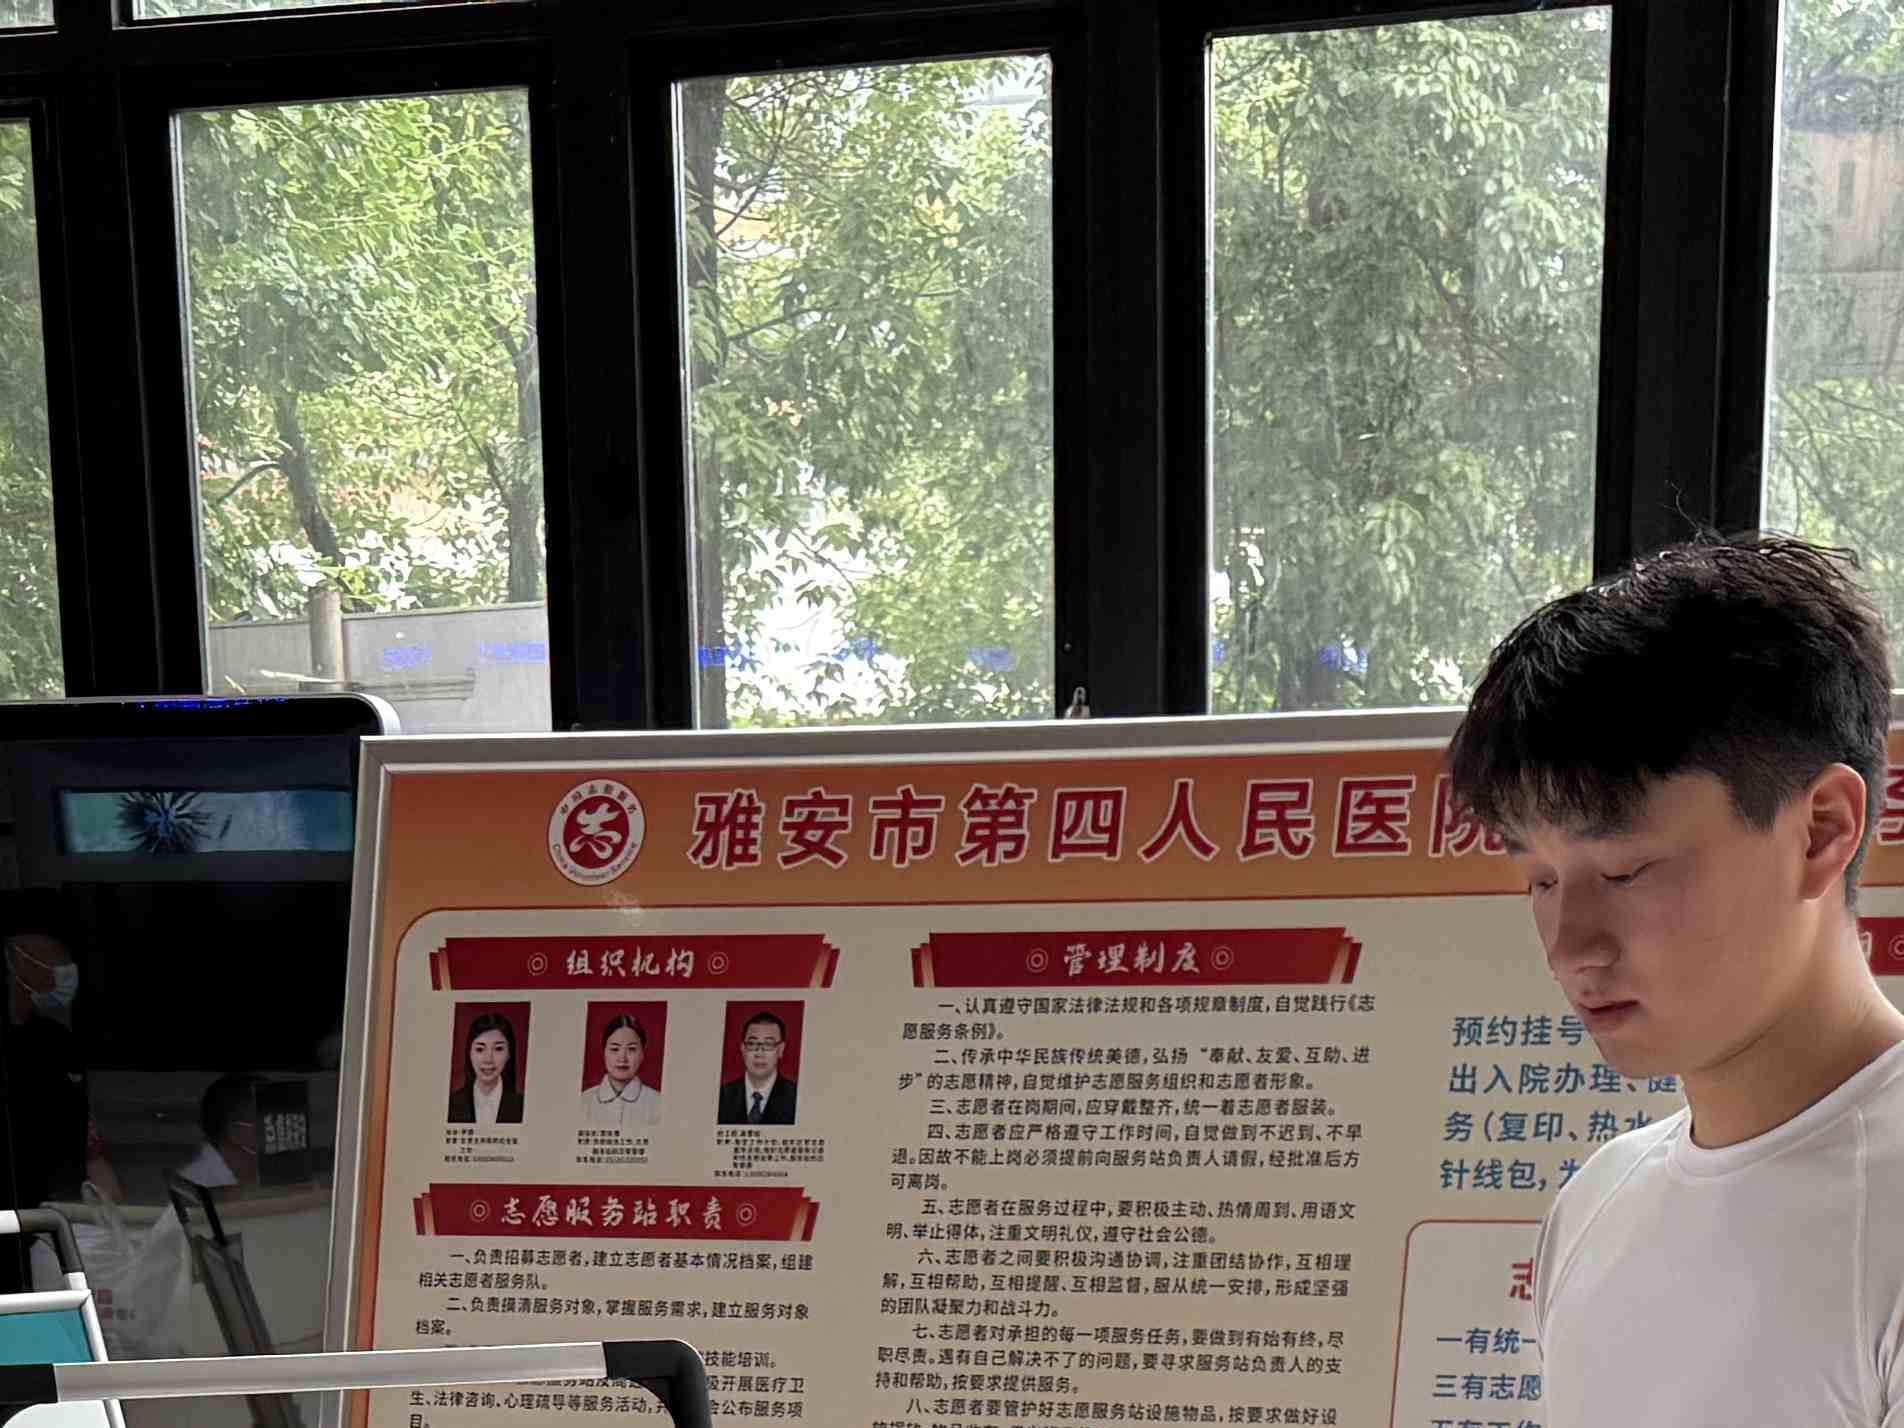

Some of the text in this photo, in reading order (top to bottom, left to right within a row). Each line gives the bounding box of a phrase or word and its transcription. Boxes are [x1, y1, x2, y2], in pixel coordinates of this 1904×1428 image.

[686, 774, 1507, 871] 雅安市第四人民医院
[566, 948, 696, 978] 组织机构
[1063, 941, 1200, 977] 管理制度
[501, 1195, 724, 1231] 志愿服务站职责
[697, 1350, 777, 1369] 技能培训。
[1431, 1373, 1543, 1401] 三有志愿
